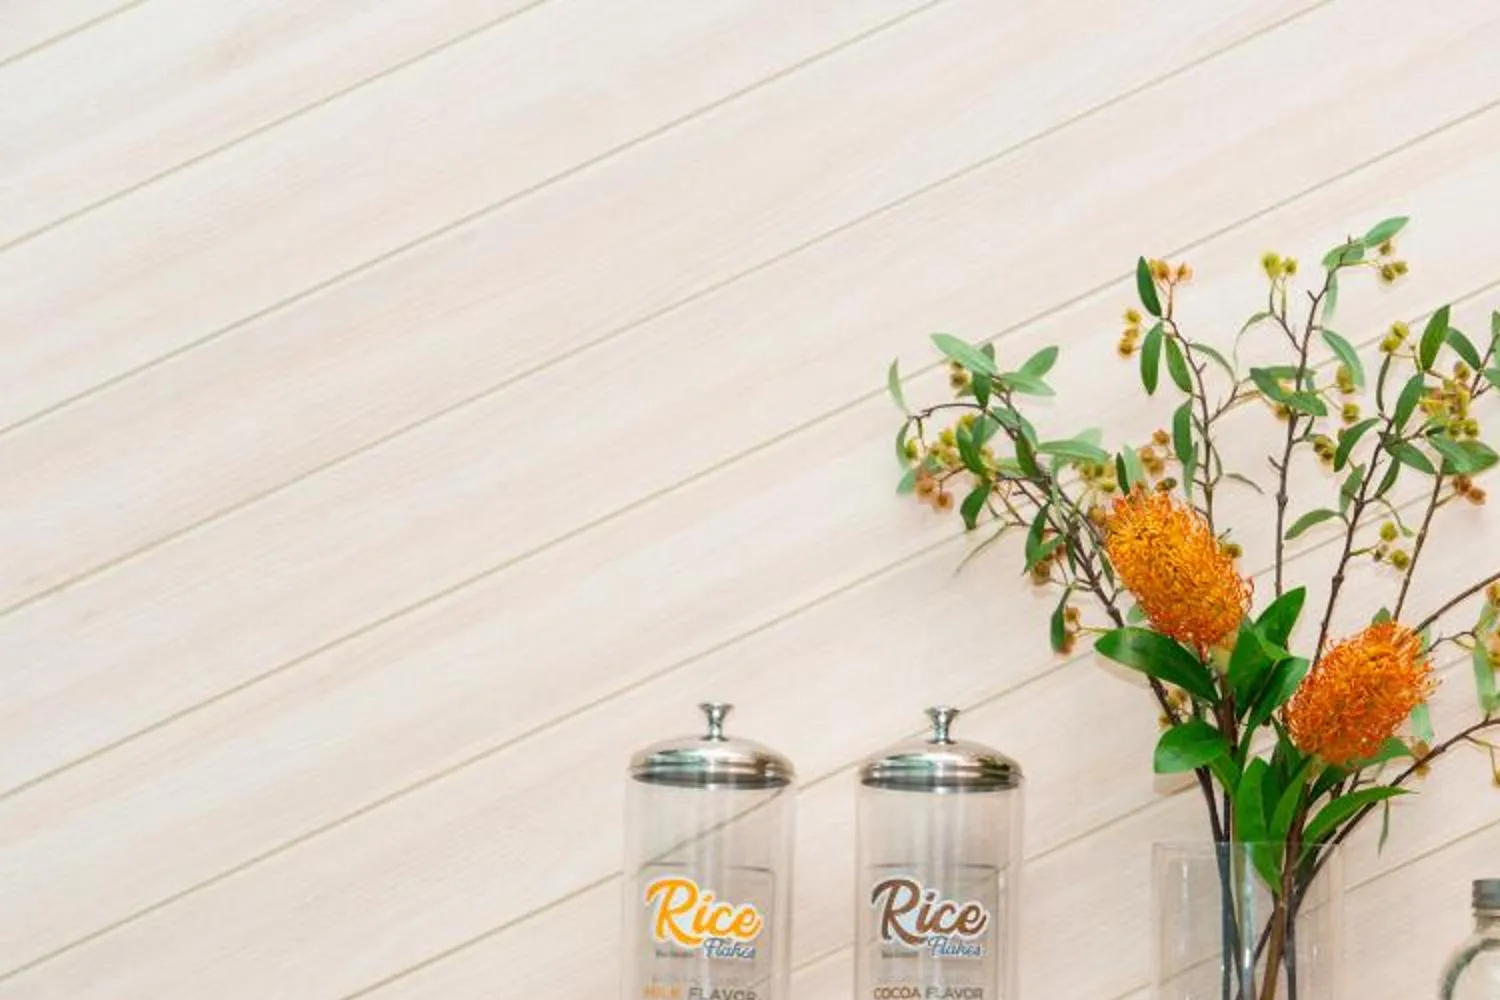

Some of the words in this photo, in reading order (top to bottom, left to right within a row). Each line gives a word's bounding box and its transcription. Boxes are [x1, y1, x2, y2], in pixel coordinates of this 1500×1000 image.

[645, 878, 763, 947] Rice
[871, 878, 988, 946] Rice
[873, 985, 921, 1000] COCOA
[925, 986, 984, 1000] FLAVOR
